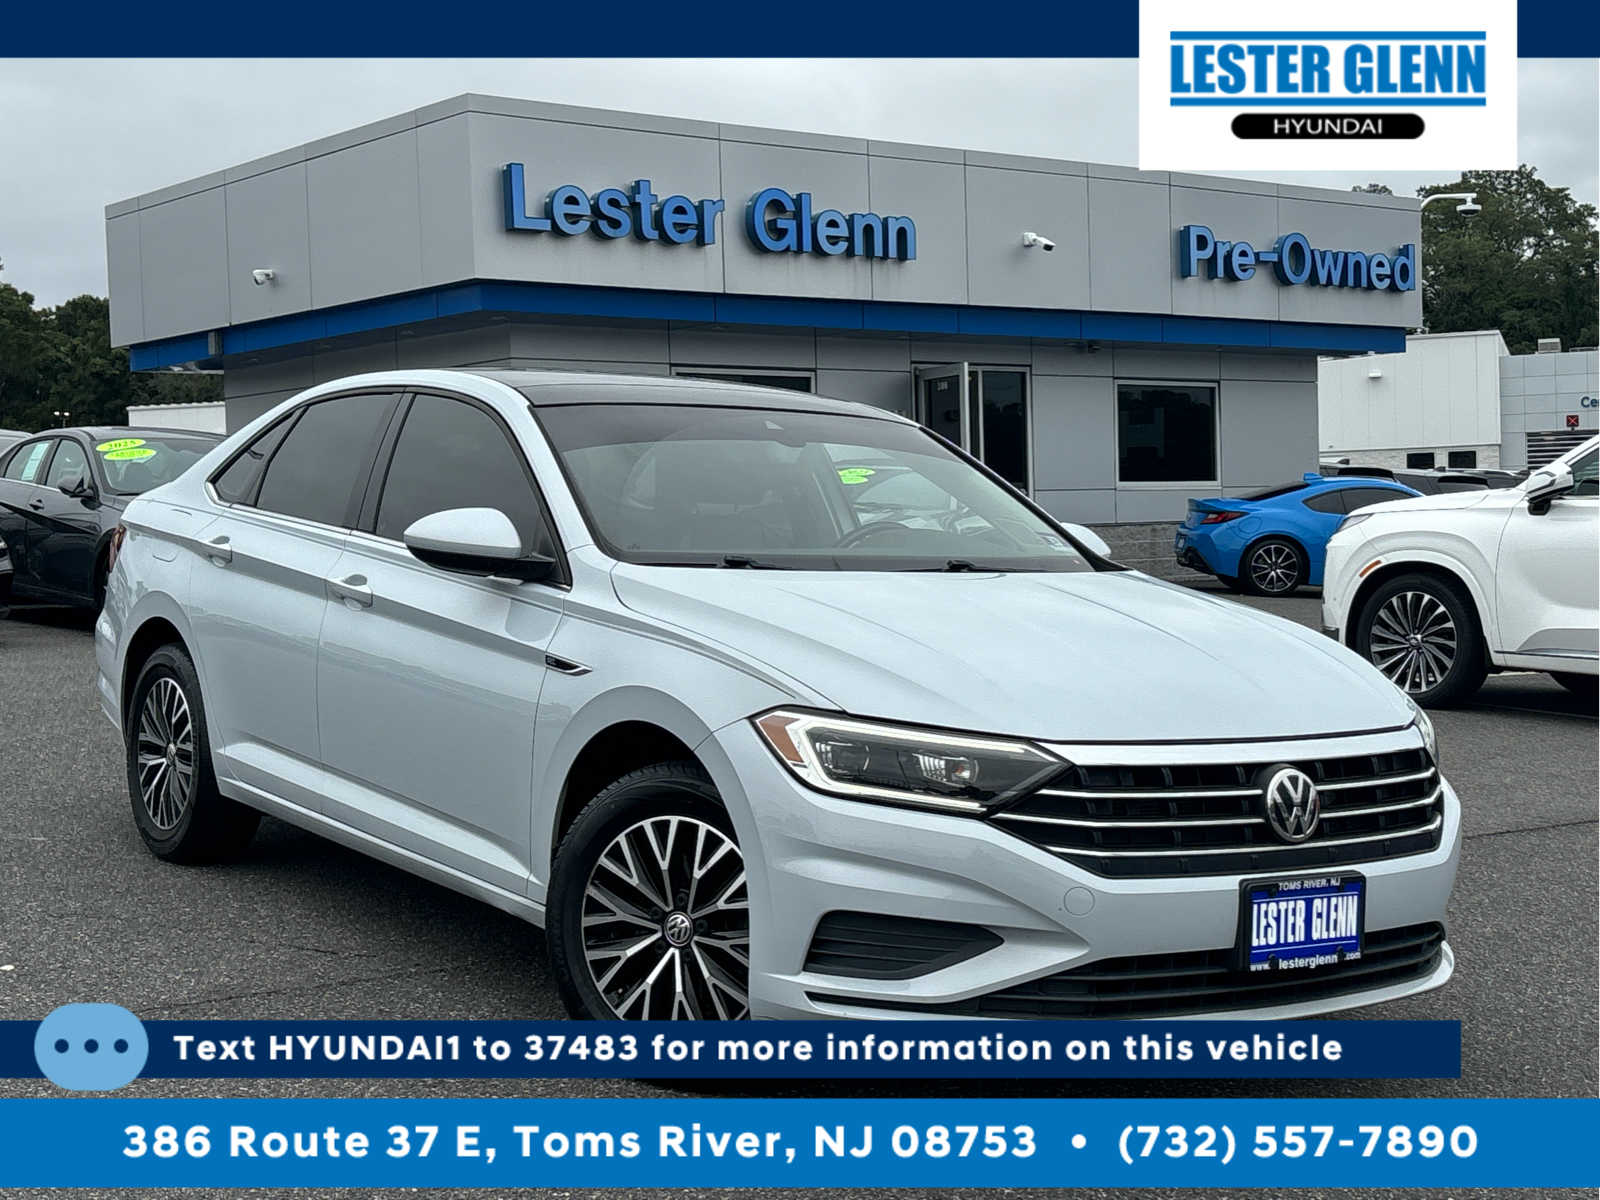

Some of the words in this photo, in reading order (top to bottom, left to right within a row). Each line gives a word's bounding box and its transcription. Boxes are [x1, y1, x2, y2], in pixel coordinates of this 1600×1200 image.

[502, 162, 725, 246] Lester
[745, 187, 917, 261] Glenn
[1180, 225, 1416, 291] Pre-Owned
[1581, 396, 1599, 408] Ce
[1278, 881, 1301, 891] TOMS
[1330, 877, 1341, 887] NJ
[1251, 900, 1306, 947] LESTER
[1311, 895, 1358, 940] GLENN
